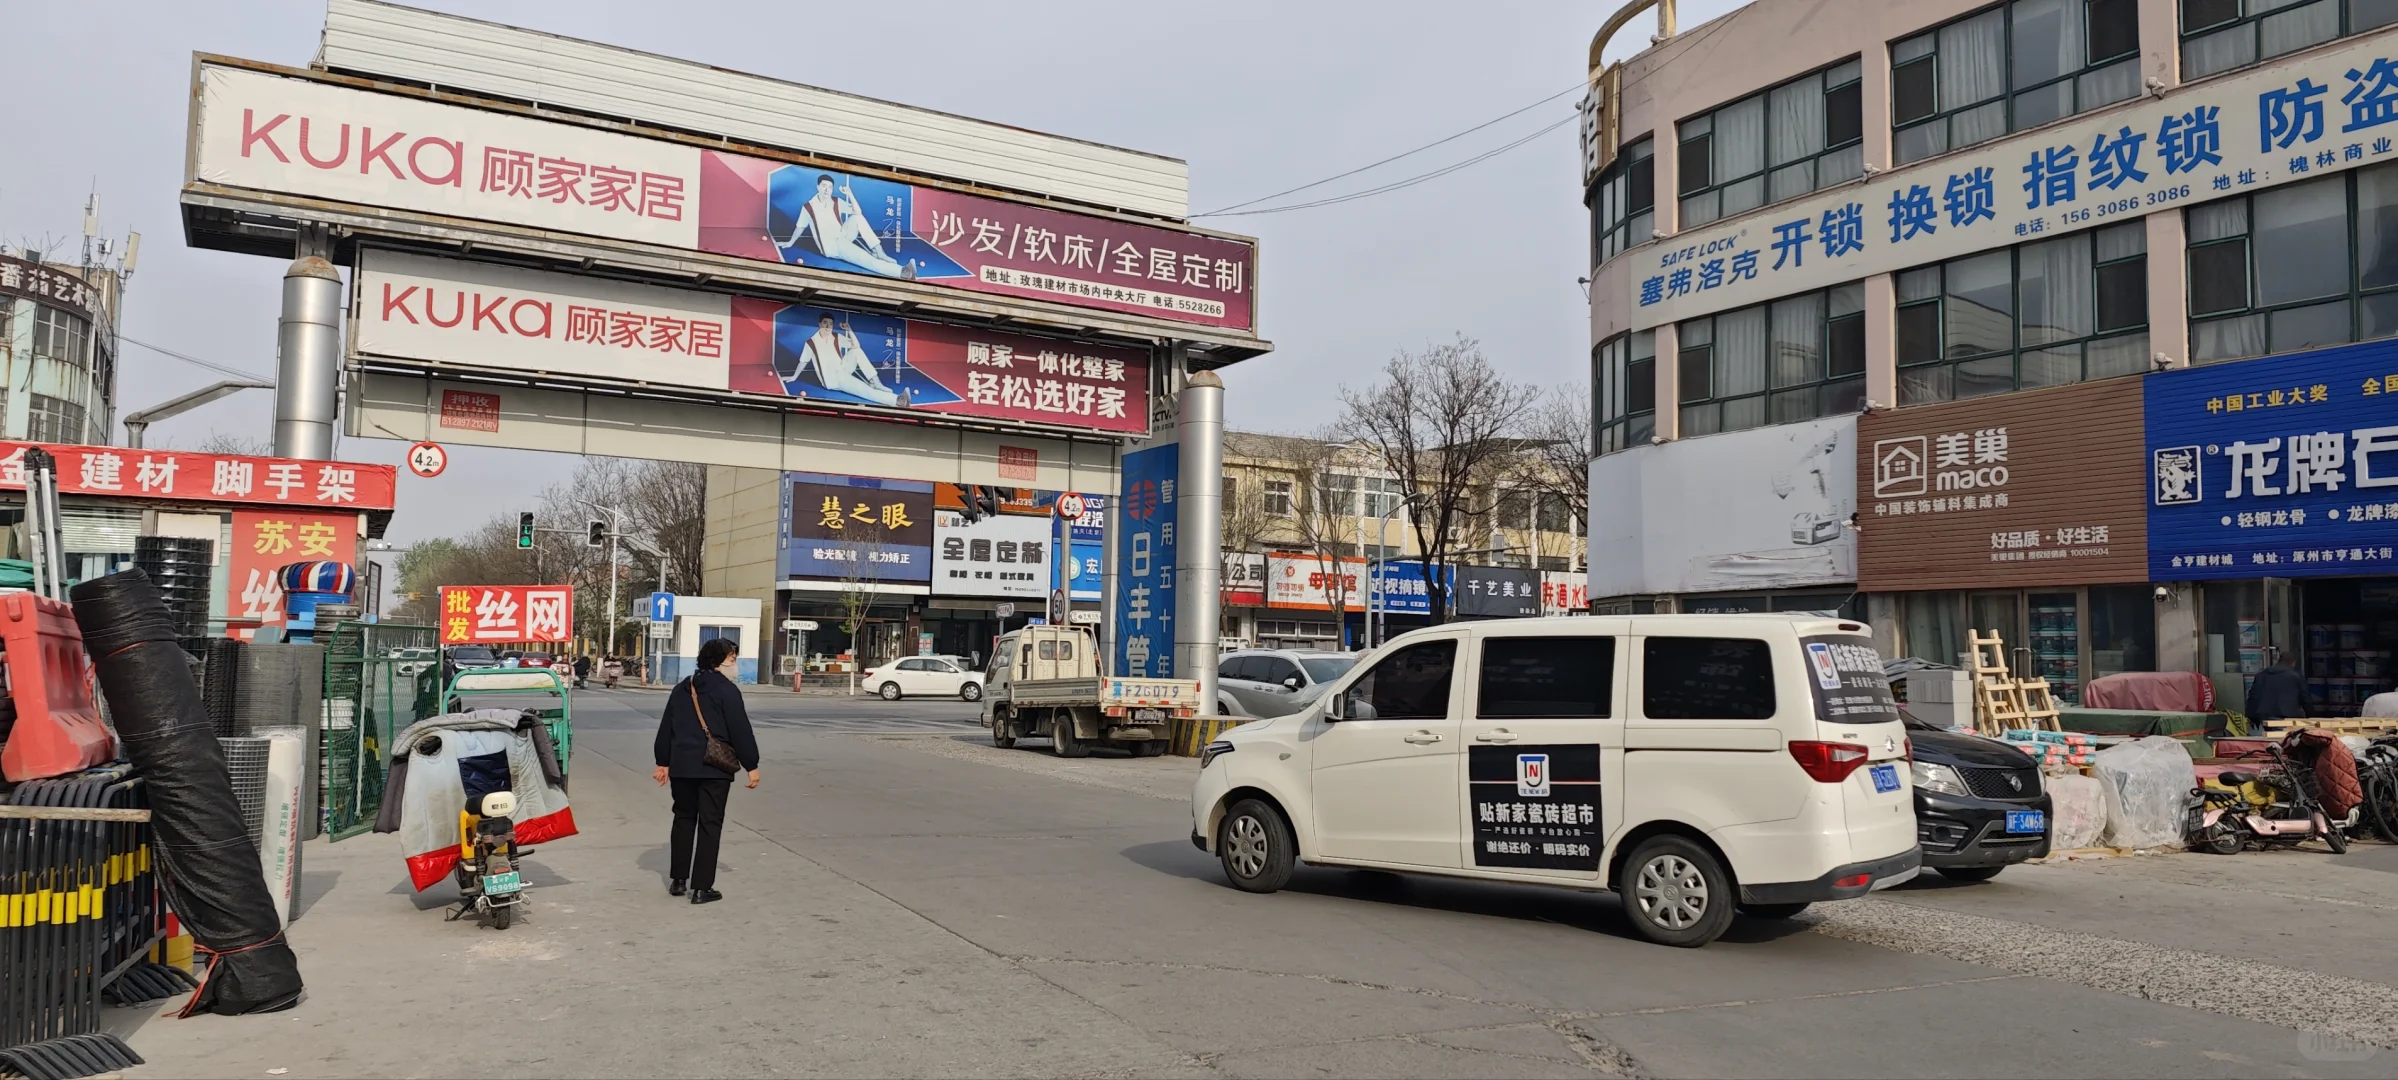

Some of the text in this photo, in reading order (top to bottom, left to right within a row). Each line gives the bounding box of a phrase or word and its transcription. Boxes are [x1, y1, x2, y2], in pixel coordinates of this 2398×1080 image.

[2022, 105, 2223, 210] 指纹锁
[2288, 137, 2393, 175] 槐林商业
[479, 146, 685, 222] 顾家家居
[1770, 166, 1997, 272] 开锁 换锁
[2061, 208, 2091, 226] 156
[2096, 196, 2140, 218] 3086
[2146, 184, 2191, 206] 3086
[930, 209, 1243, 294] 沙发/软床/全屋定制
[1660, 235, 1738, 269] SAFE LOCK
[1639, 248, 1760, 307] 塞弗洛克
[564, 304, 724, 359] 顾家家居
[966, 340, 1126, 383] 顾家一体化整家
[967, 370, 1127, 419] 轻松选好家
[2206, 383, 2329, 415] 中国工业大奖
[414, 452, 440, 467] 4.2m
[1935, 427, 2008, 469] 美巢
[2224, 425, 2398, 499] 龙牌石
[80, 451, 180, 494] 建材
[211, 459, 356, 503] 脚手架
[1936, 465, 2009, 491] maco
[817, 495, 914, 531] 慧之眼
[1874, 492, 2009, 517] 中国装饰辅料集成商
[2237, 509, 2307, 528] 轻钢龙骨
[253, 520, 338, 557] 苏安
[813, 548, 858, 562] 验光配镜
[943, 536, 1043, 564] 全屋定制
[2070, 548, 2110, 558] 10001504
[2293, 546, 2393, 563] 涿州市亨通大街
[1157, 479, 1174, 679] 管用五十年
[1467, 579, 1532, 598] 千艺美业
[446, 590, 567, 641] 批发 丝网
[1054, 598, 1063, 615] 50
[1126, 532, 1151, 678] 日丰管
[1479, 801, 1594, 825] 贴新家瓷砖超市
[486, 882, 519, 893] VS9098
